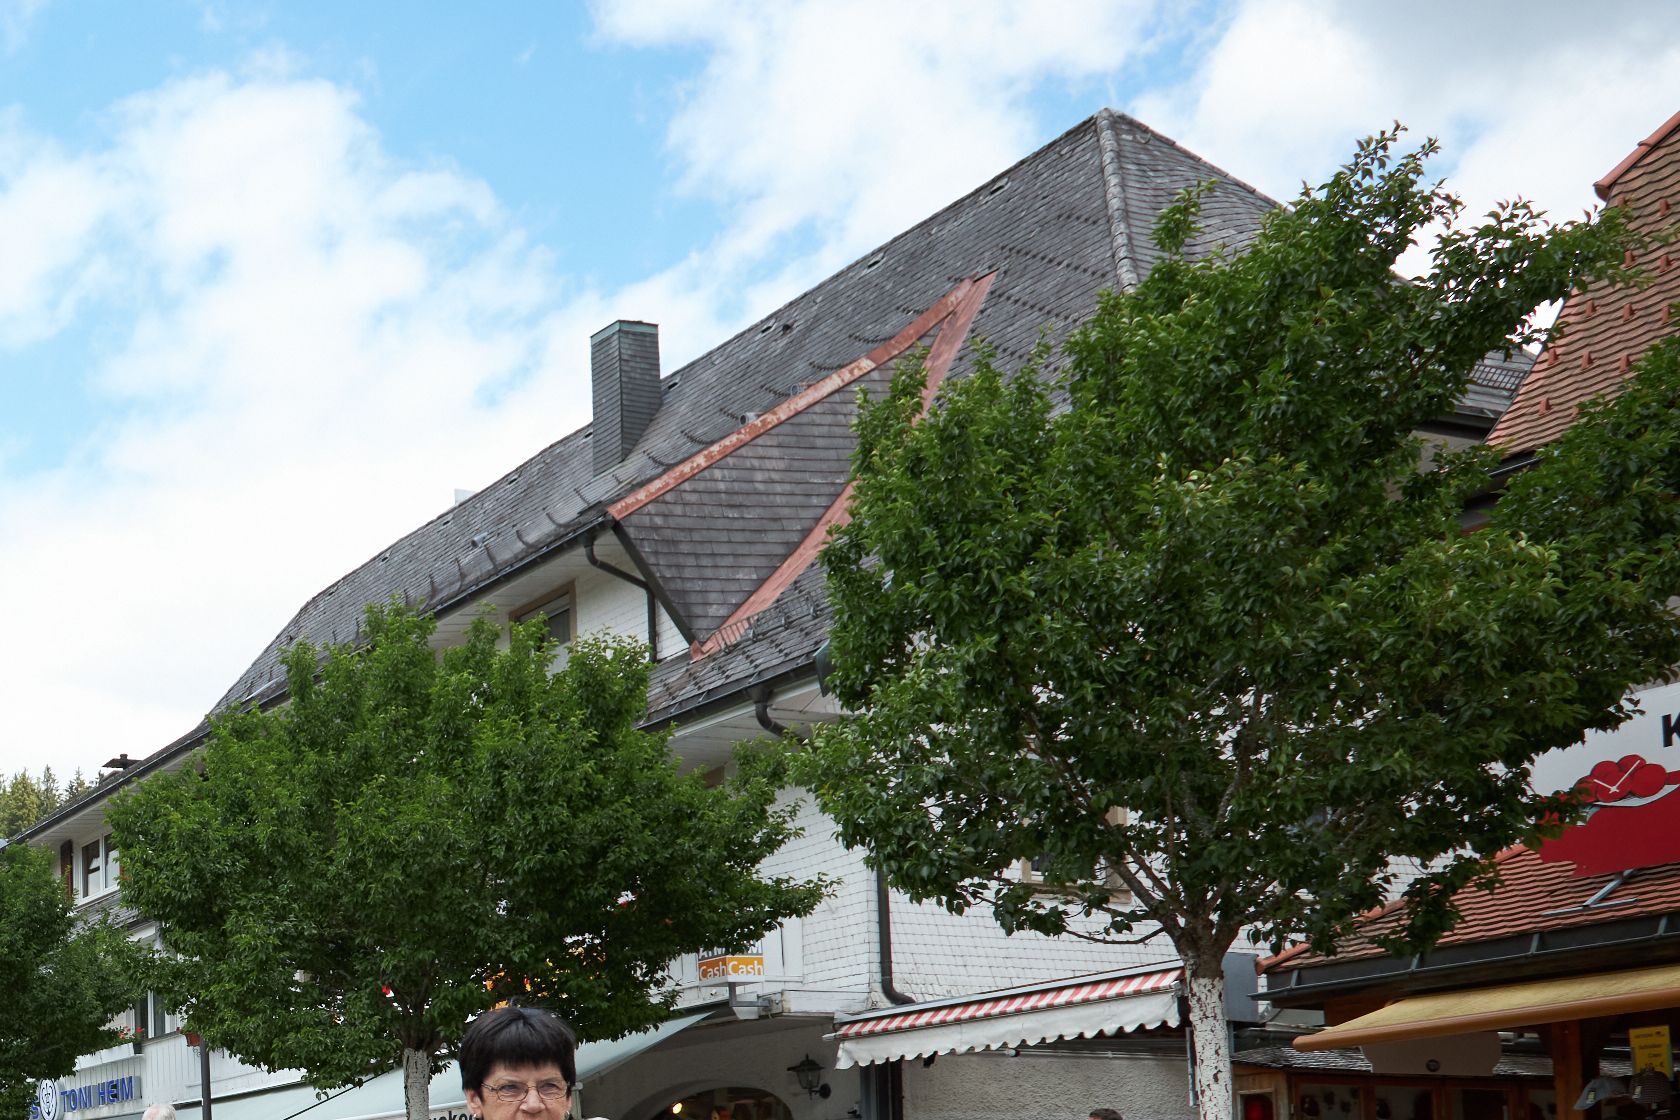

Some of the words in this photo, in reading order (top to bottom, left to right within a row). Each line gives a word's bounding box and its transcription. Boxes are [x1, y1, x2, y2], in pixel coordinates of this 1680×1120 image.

[700, 962, 727, 980] Cash
[728, 960, 763, 976] Cash
[60, 1085, 94, 1113] TONI
[97, 1075, 134, 1106] HEIM
